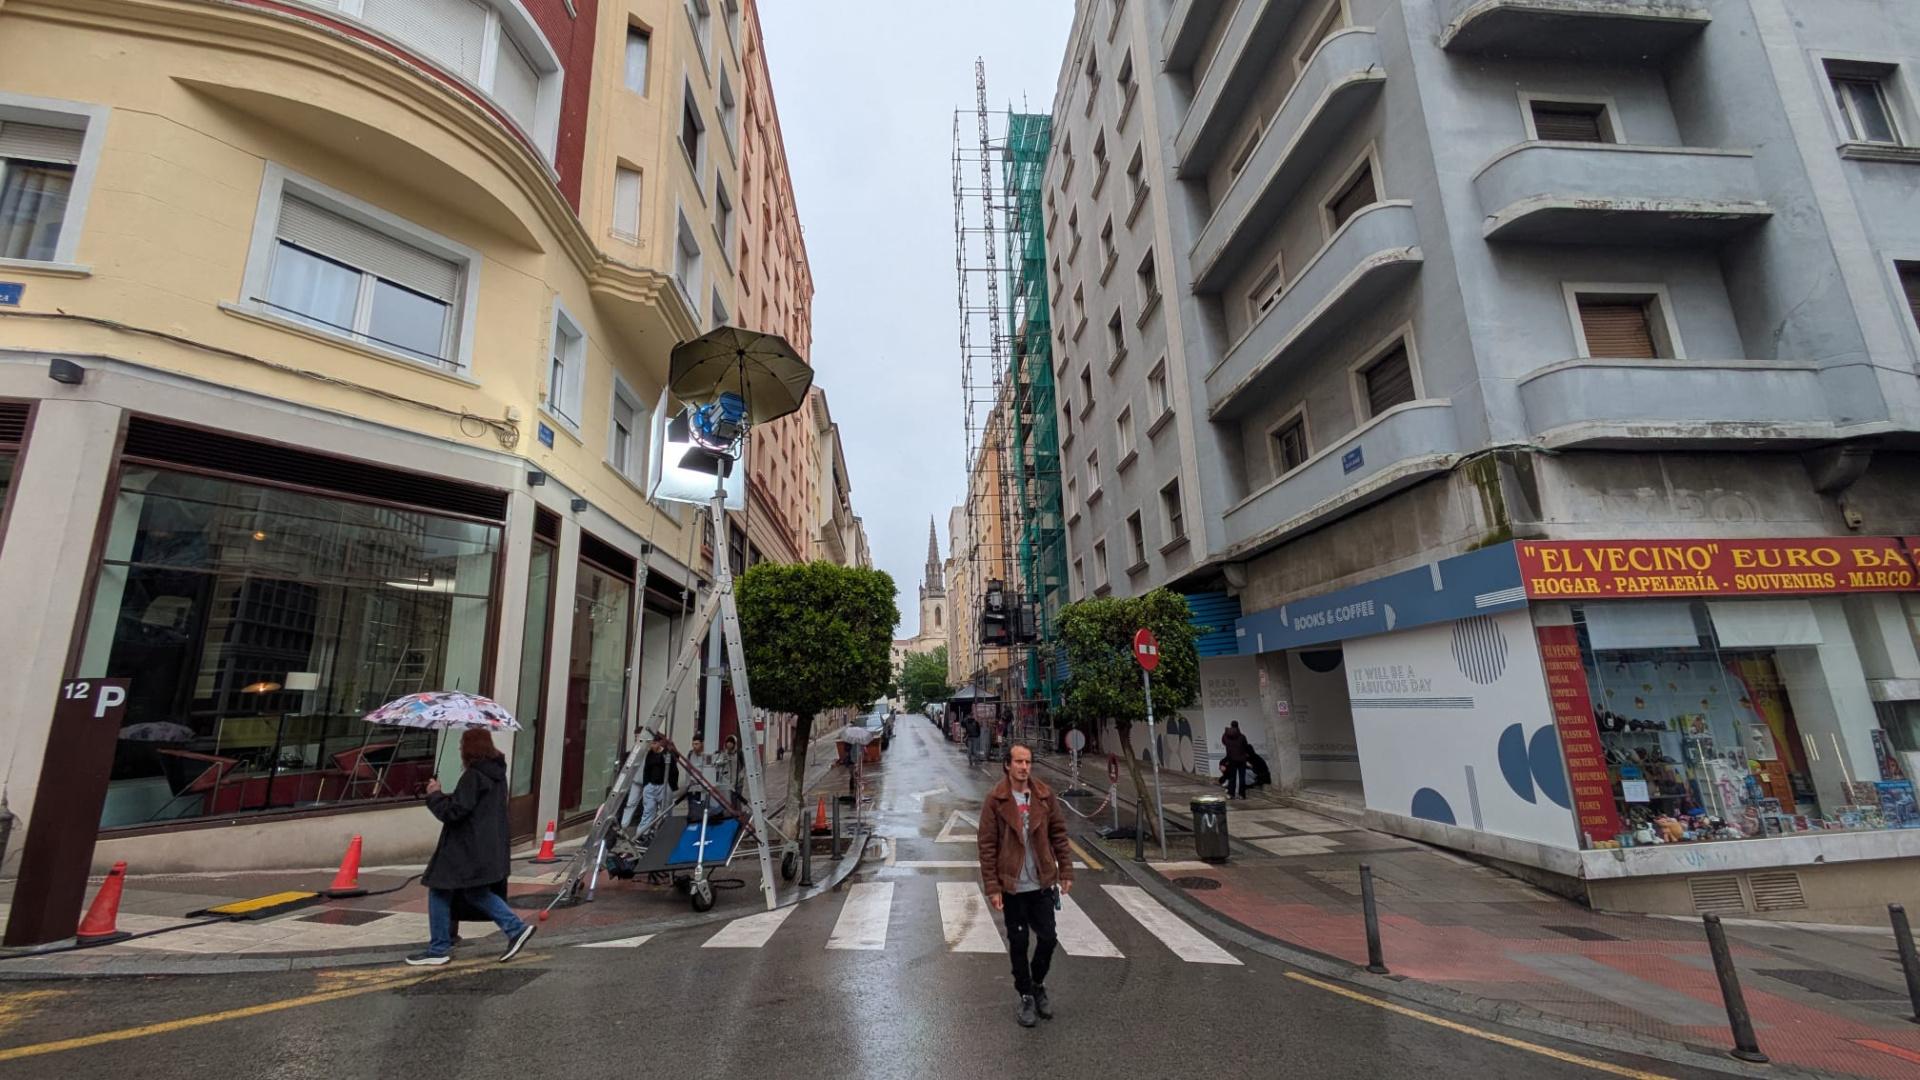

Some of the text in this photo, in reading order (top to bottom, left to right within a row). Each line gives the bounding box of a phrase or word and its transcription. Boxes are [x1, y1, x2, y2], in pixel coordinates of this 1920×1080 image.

[1583, 543, 1719, 572] VECINO"
[1731, 547, 1842, 568] EURO
[1851, 547, 1920, 568] BA
[1531, 577, 1601, 594] HOGAR
[1613, 571, 1720, 593] PAPELERÍA
[1735, 572, 1836, 590] SOUVENIRS
[1848, 570, 1920, 587] MARCO
[1294, 611, 1326, 631] BOOKS
[1335, 600, 1375, 622] COFFEE
[1352, 667, 1362, 681] IT
[1364, 666, 1389, 681] WILL
[1391, 664, 1404, 679] BE
[65, 682, 126, 717] 12 P
[1355, 678, 1432, 695] FABULOUS DAY
